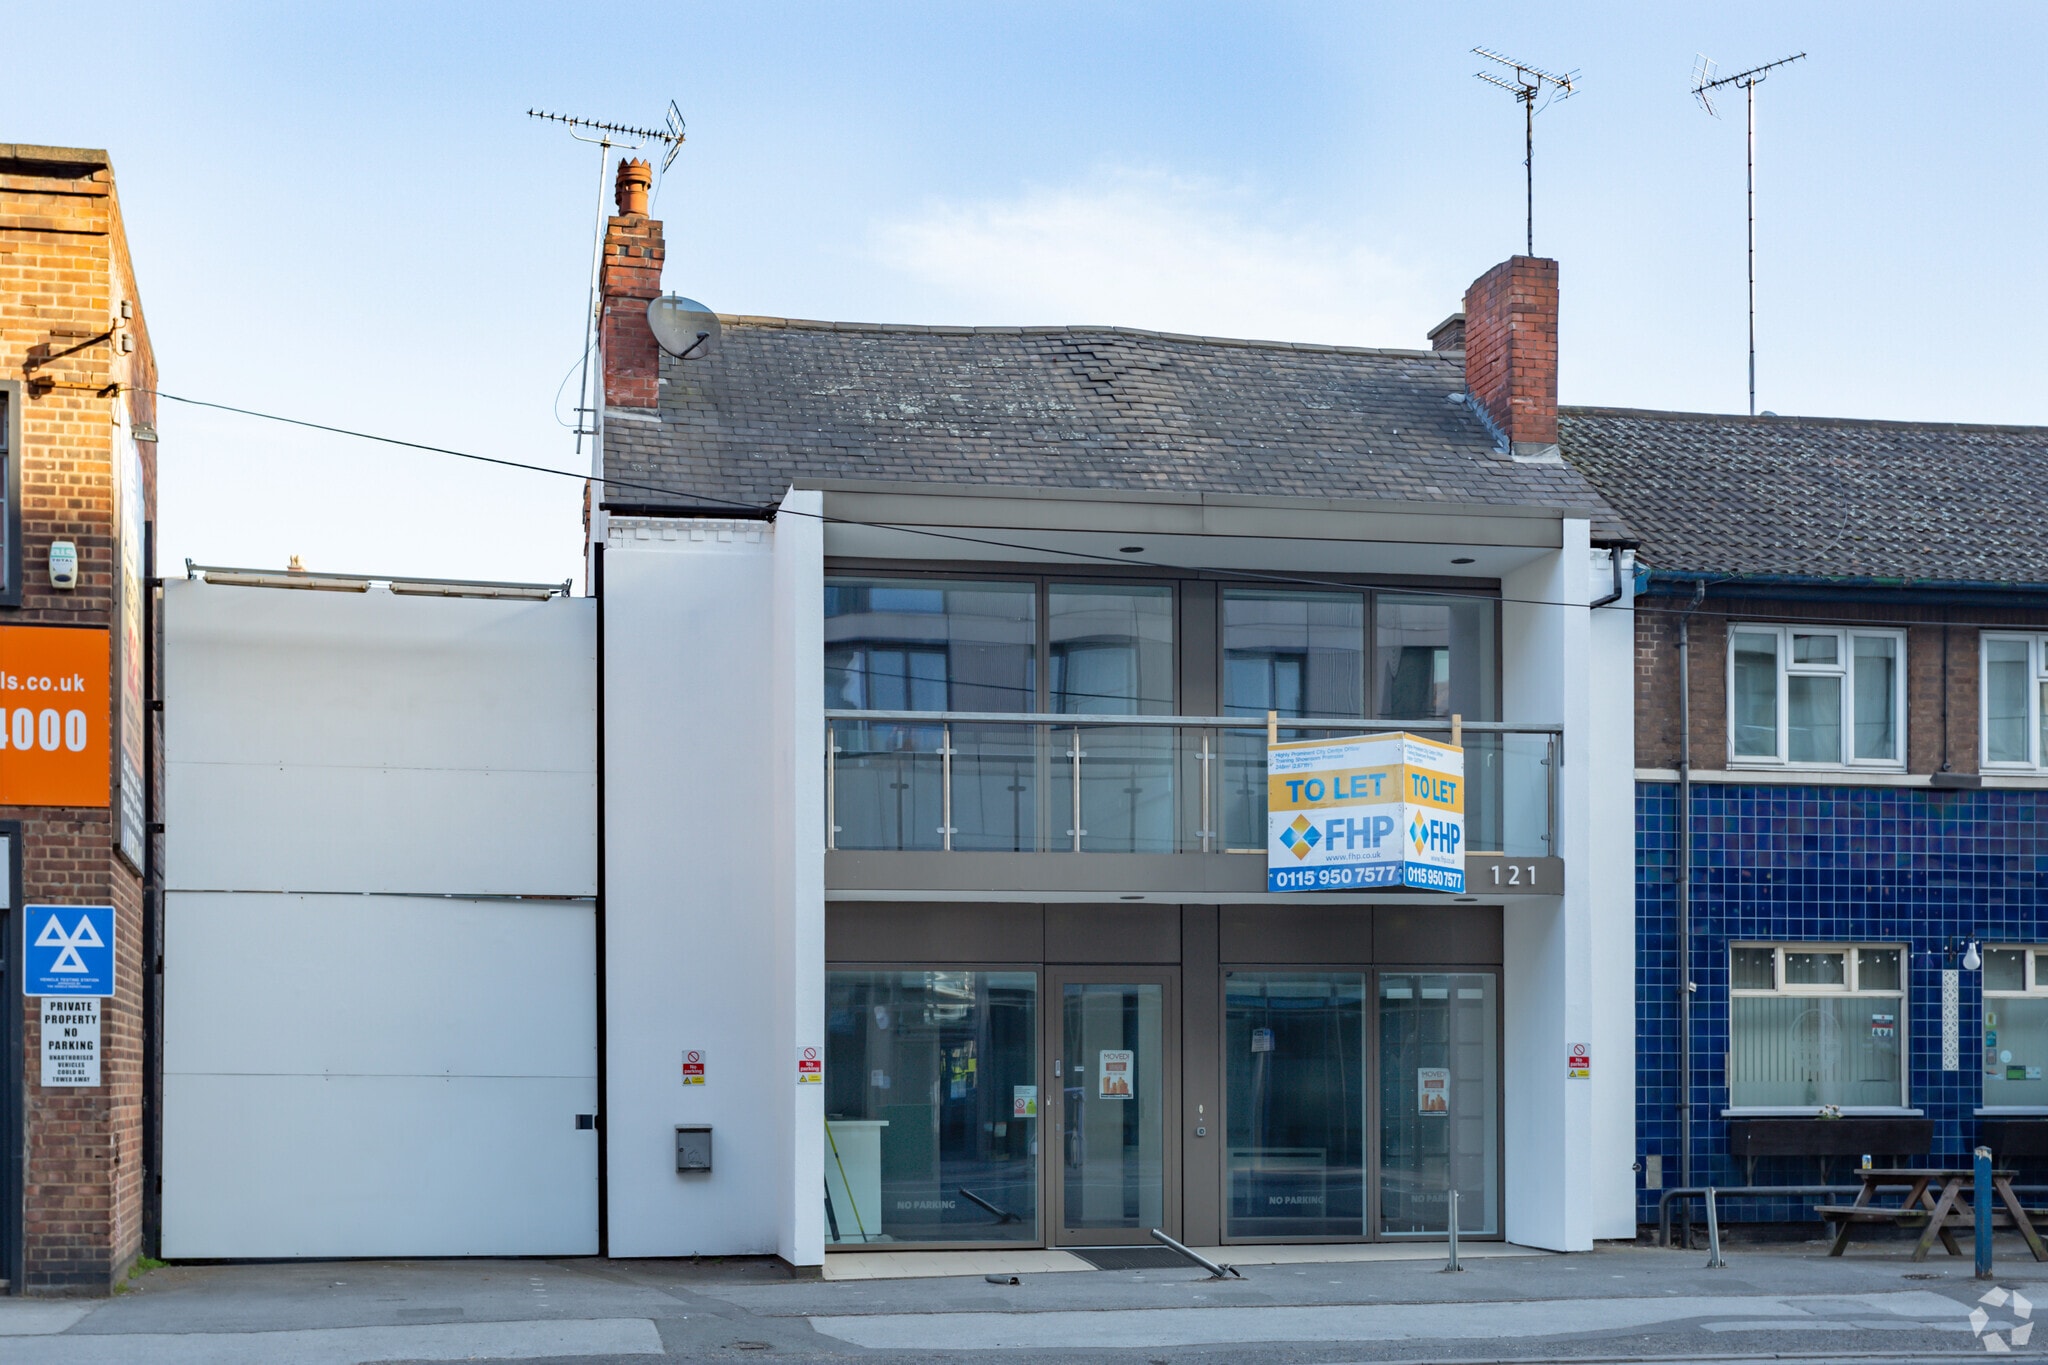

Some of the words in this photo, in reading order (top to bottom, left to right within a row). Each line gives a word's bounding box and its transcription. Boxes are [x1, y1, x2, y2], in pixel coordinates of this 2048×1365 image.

[0, 671, 85, 692] ls.co.uk
[1275, 751, 1290, 759] Highly
[1291, 749, 1315, 757] Prominent
[1327, 747, 1343, 755] Centre
[1286, 779, 1325, 803] TO
[1333, 773, 1387, 800] LET
[1412, 773, 1430, 799] TO
[1433, 777, 1456, 804] LET
[1325, 815, 1395, 851] FHP
[1430, 819, 1460, 854] FHP
[1326, 851, 1381, 862] www.fhp.co.uk
[1276, 870, 1315, 887] 0115
[1319, 868, 1353, 885] 950
[1354, 866, 1396, 883] 7577
[1408, 866, 1426, 883] 0115
[1428, 870, 1442, 886] 950
[1444, 873, 1461, 888] 7577
[1491, 865, 1536, 885] 121
[50, 1002, 92, 1011] PRIVATE
[45, 1015, 97, 1024] PROPERTY
[64, 1028, 77, 1037] NO
[49, 1041, 94, 1050] PARKING
[1269, 1196, 1283, 1205] NO
[1285, 1196, 1325, 1204] PARKING
[1411, 1194, 1424, 1202] NO
[1427, 1194, 1465, 1202] PARKG
[897, 1201, 912, 1209] NO
[913, 1201, 956, 1209] PARKING
